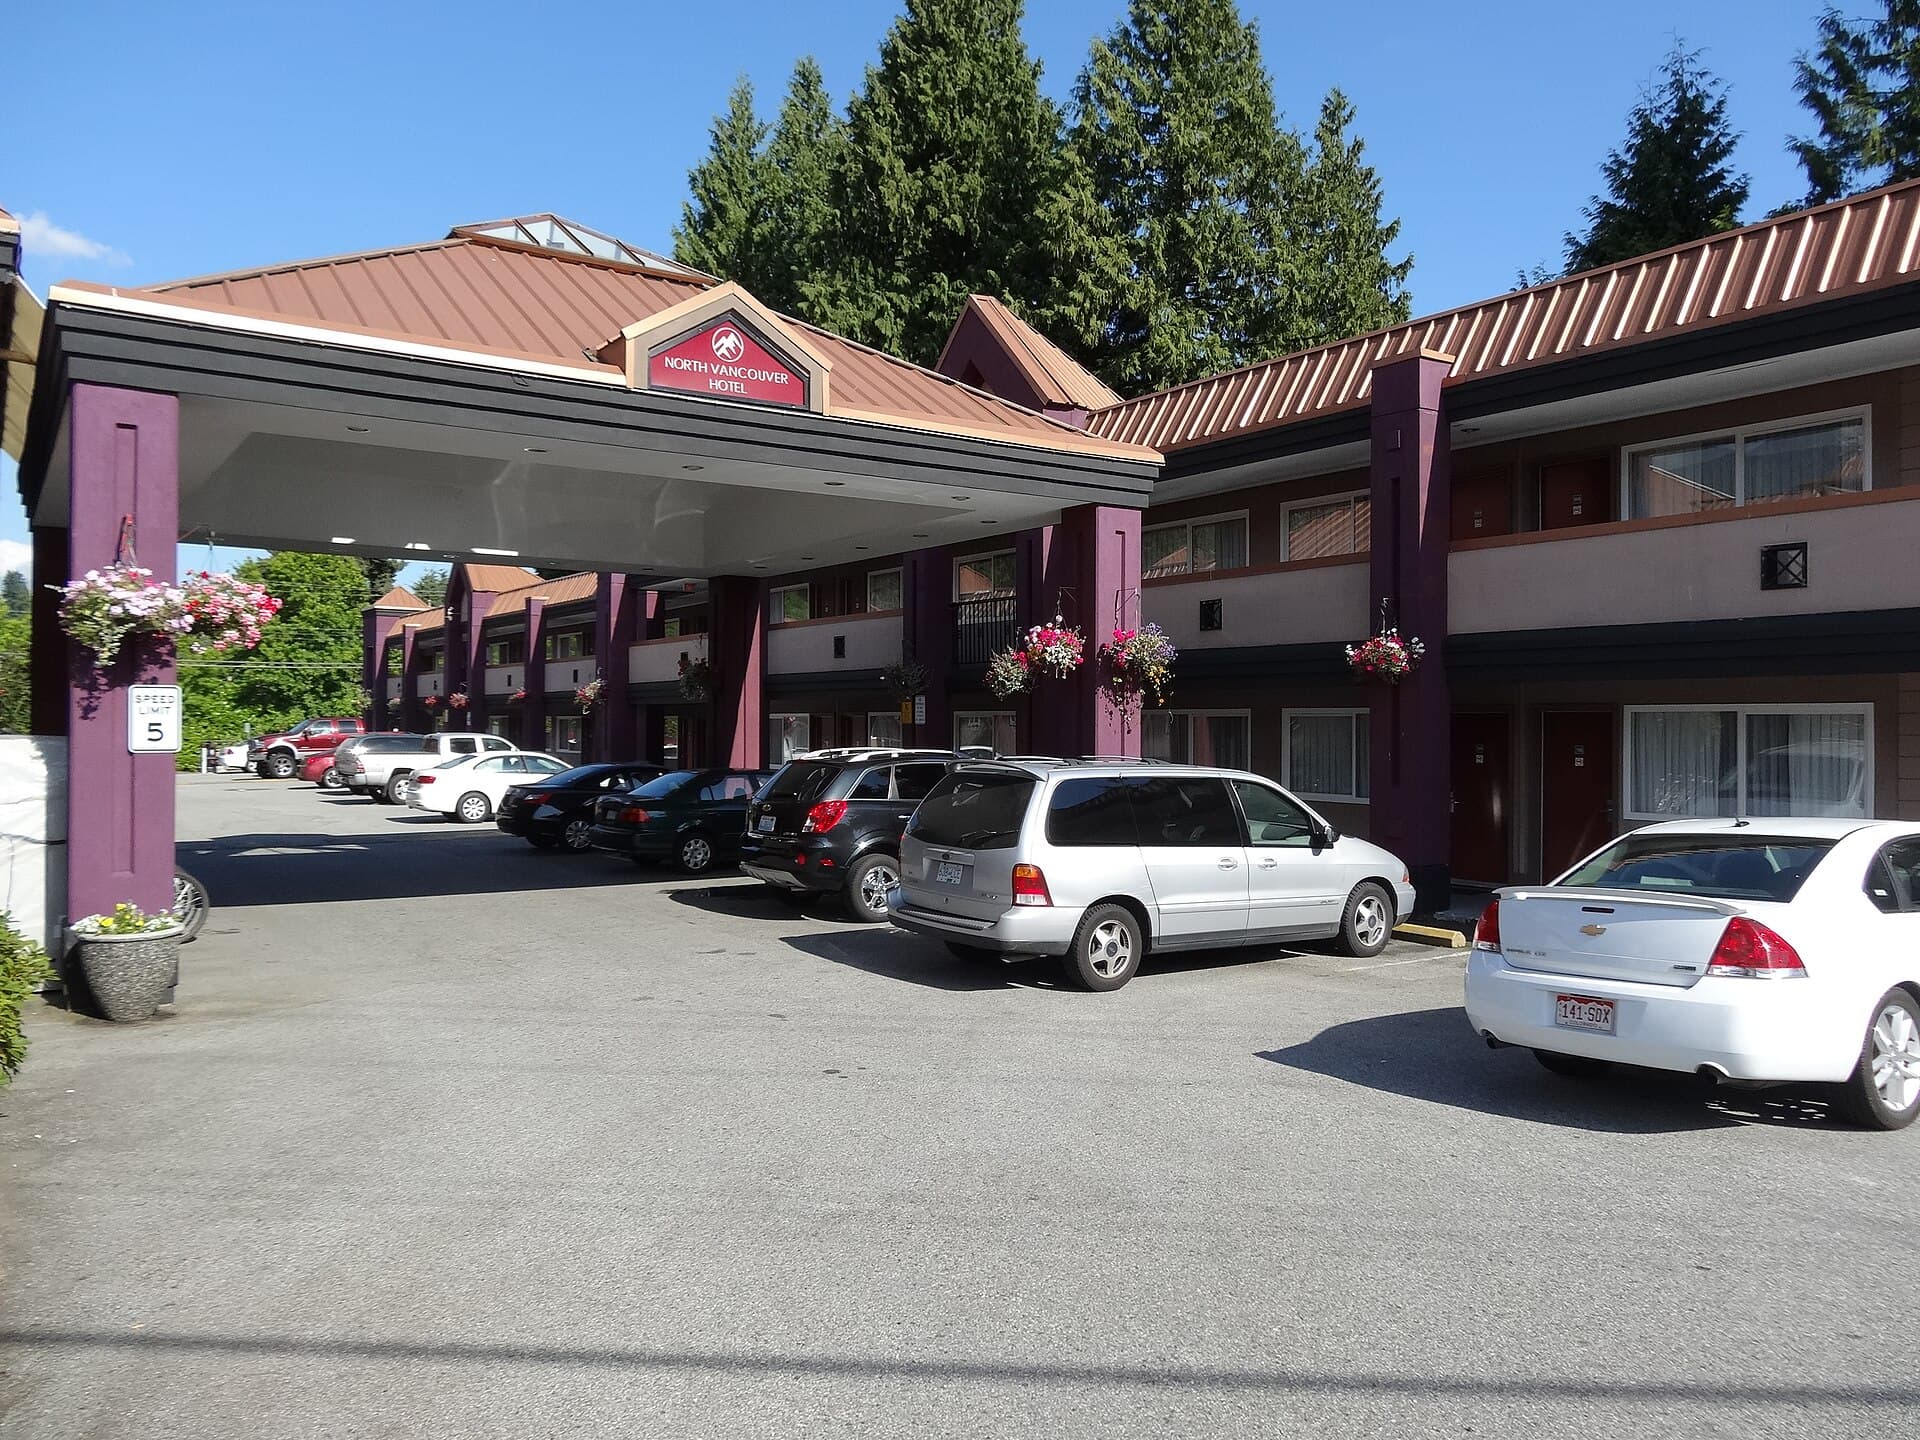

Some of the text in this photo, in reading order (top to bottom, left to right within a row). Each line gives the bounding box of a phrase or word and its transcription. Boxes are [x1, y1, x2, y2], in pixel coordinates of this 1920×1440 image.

[664, 357, 788, 384] NORTH VANCOUVER
[709, 379, 747, 394] HOTEL
[135, 695, 175, 703] SPEED
[139, 706, 171, 715] LIMIT
[147, 722, 163, 742] 5
